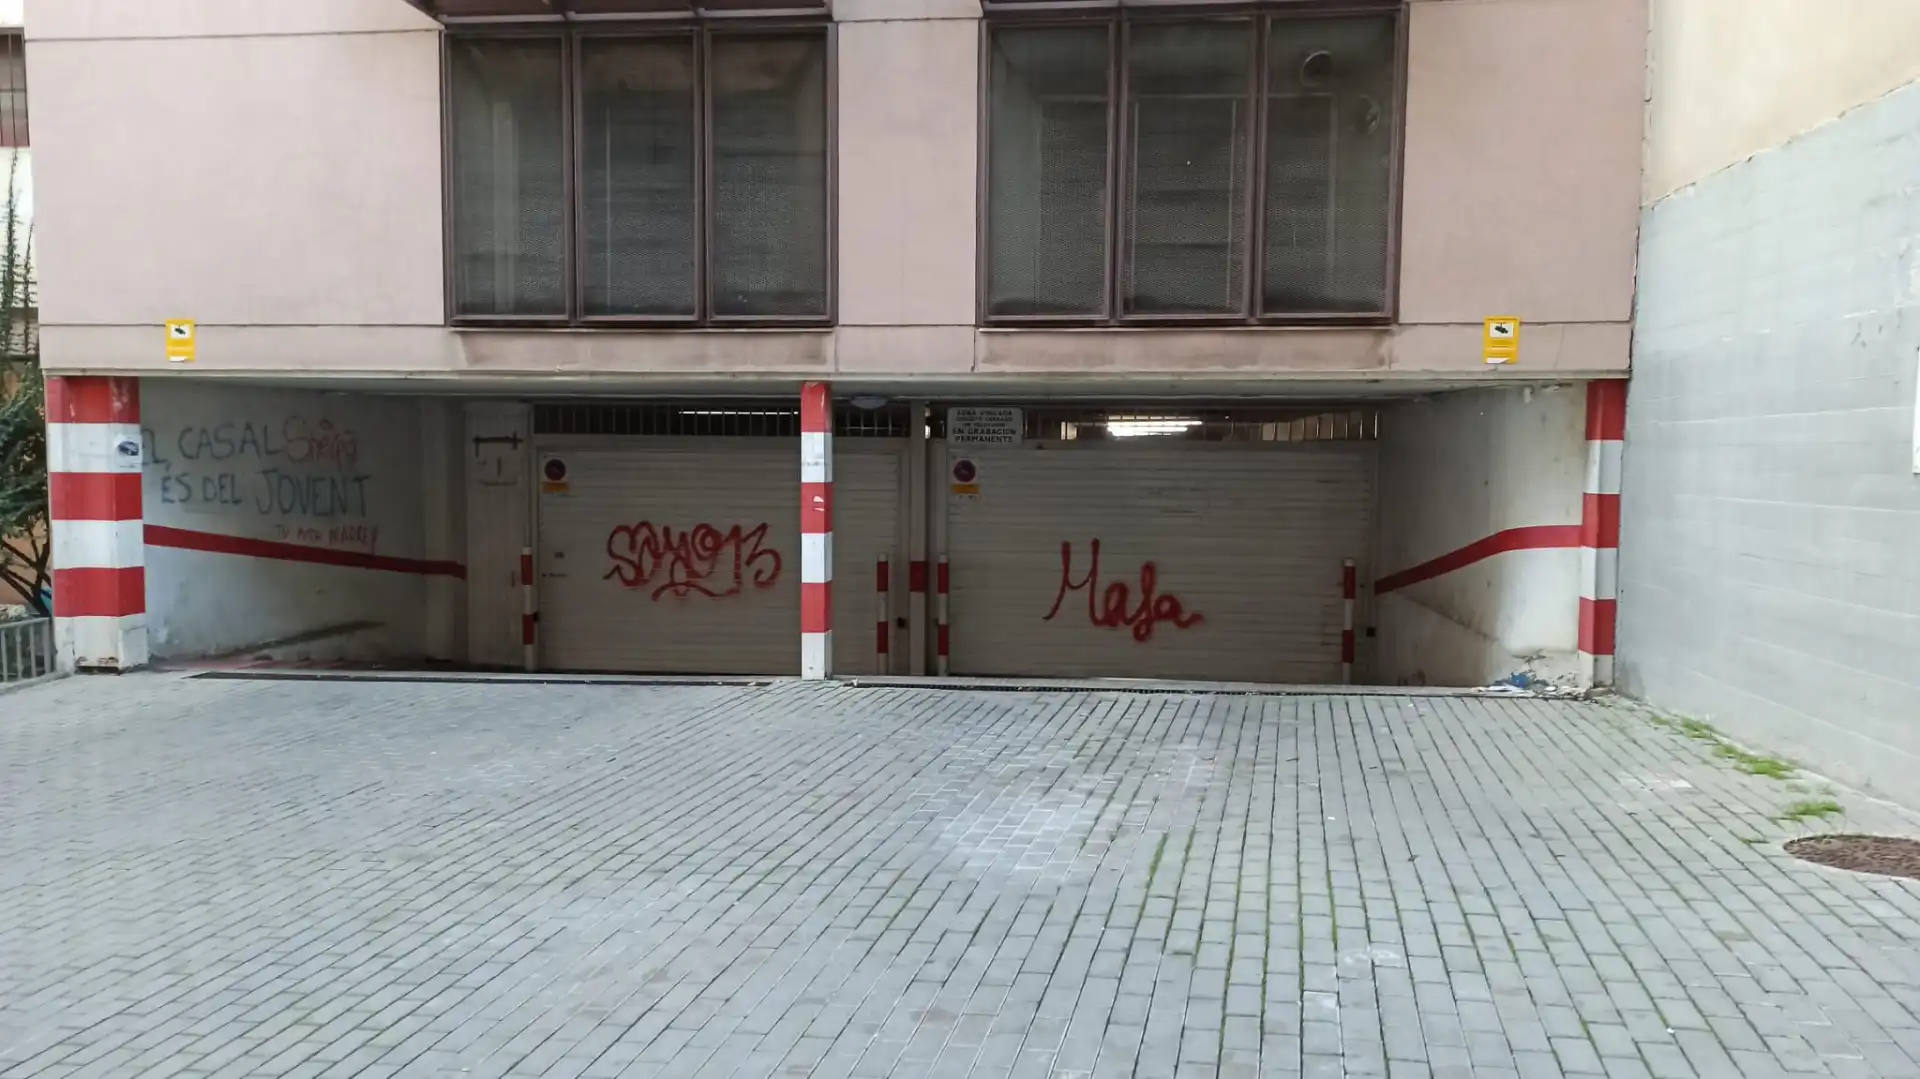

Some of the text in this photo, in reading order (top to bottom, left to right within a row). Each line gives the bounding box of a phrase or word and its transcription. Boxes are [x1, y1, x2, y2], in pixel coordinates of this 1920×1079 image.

[178, 421, 283, 460] CASAL
[202, 473, 244, 505] DEL
[256, 468, 372, 518] JOVENT
